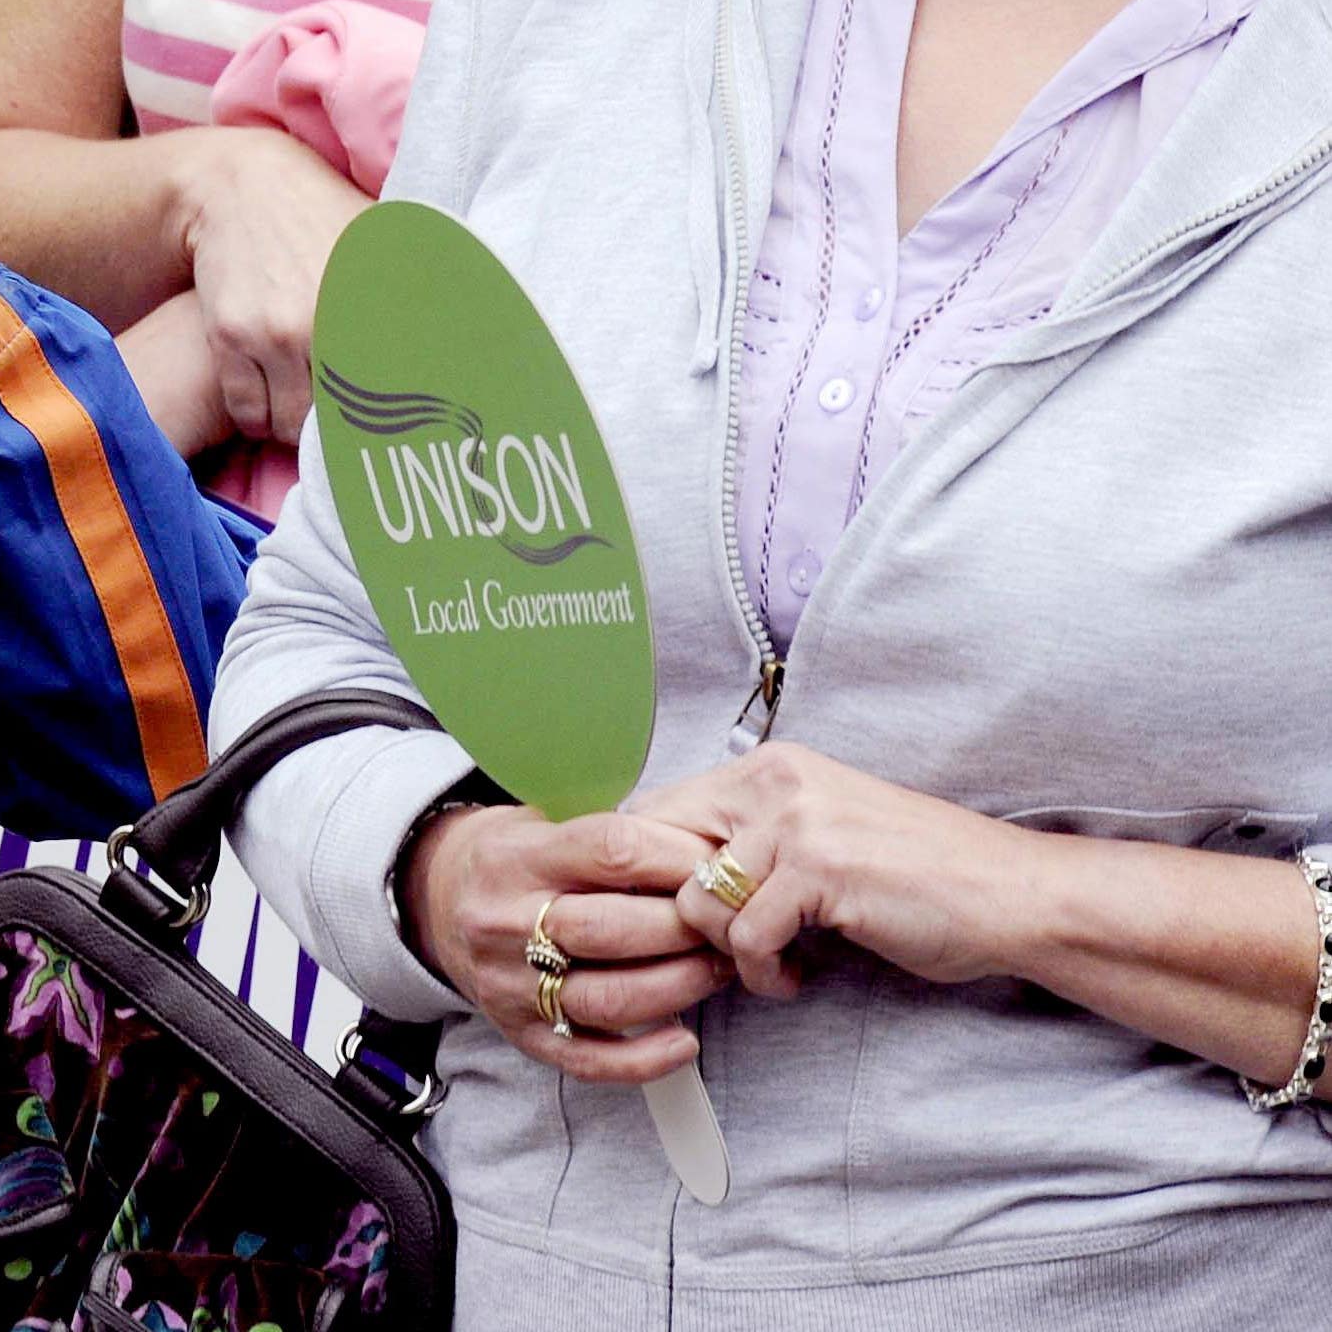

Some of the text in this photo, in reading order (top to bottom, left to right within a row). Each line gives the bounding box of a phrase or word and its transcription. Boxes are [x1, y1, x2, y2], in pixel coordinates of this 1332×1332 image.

[361, 432, 592, 544] UNISON
[405, 578, 636, 635] Local Government
